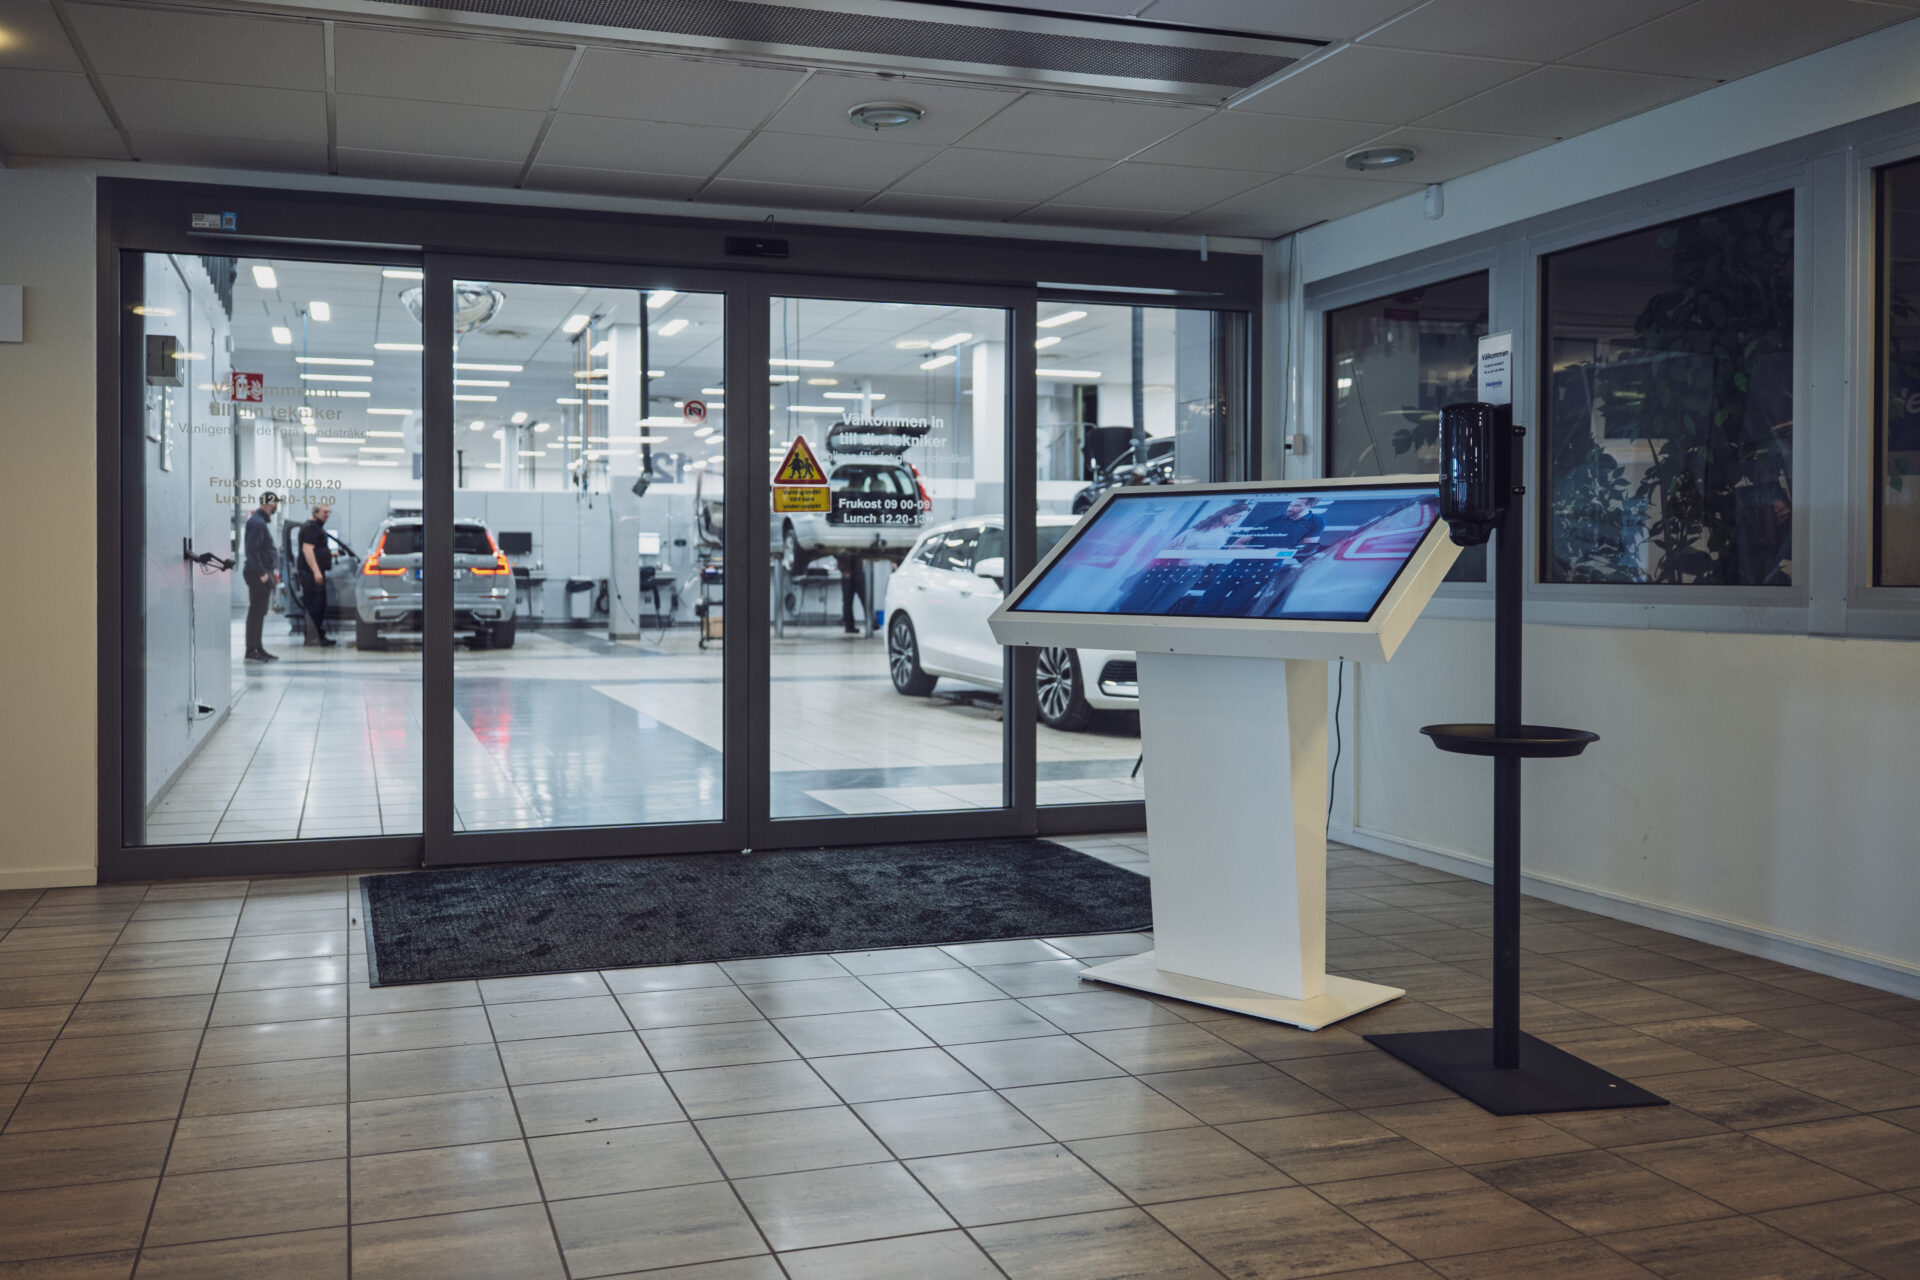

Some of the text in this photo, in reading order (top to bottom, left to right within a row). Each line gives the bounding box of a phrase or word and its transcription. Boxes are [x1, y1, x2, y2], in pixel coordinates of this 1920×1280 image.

[209, 401, 231, 417] till
[842, 412, 944, 429] Välkommen in
[839, 431, 947, 448] till din tekniker
[209, 476, 342, 490] Frukost 09.00-09.20
[215, 493, 256, 505] Lunch
[838, 498, 882, 509] Frukost
[843, 513, 877, 524] Lunch
